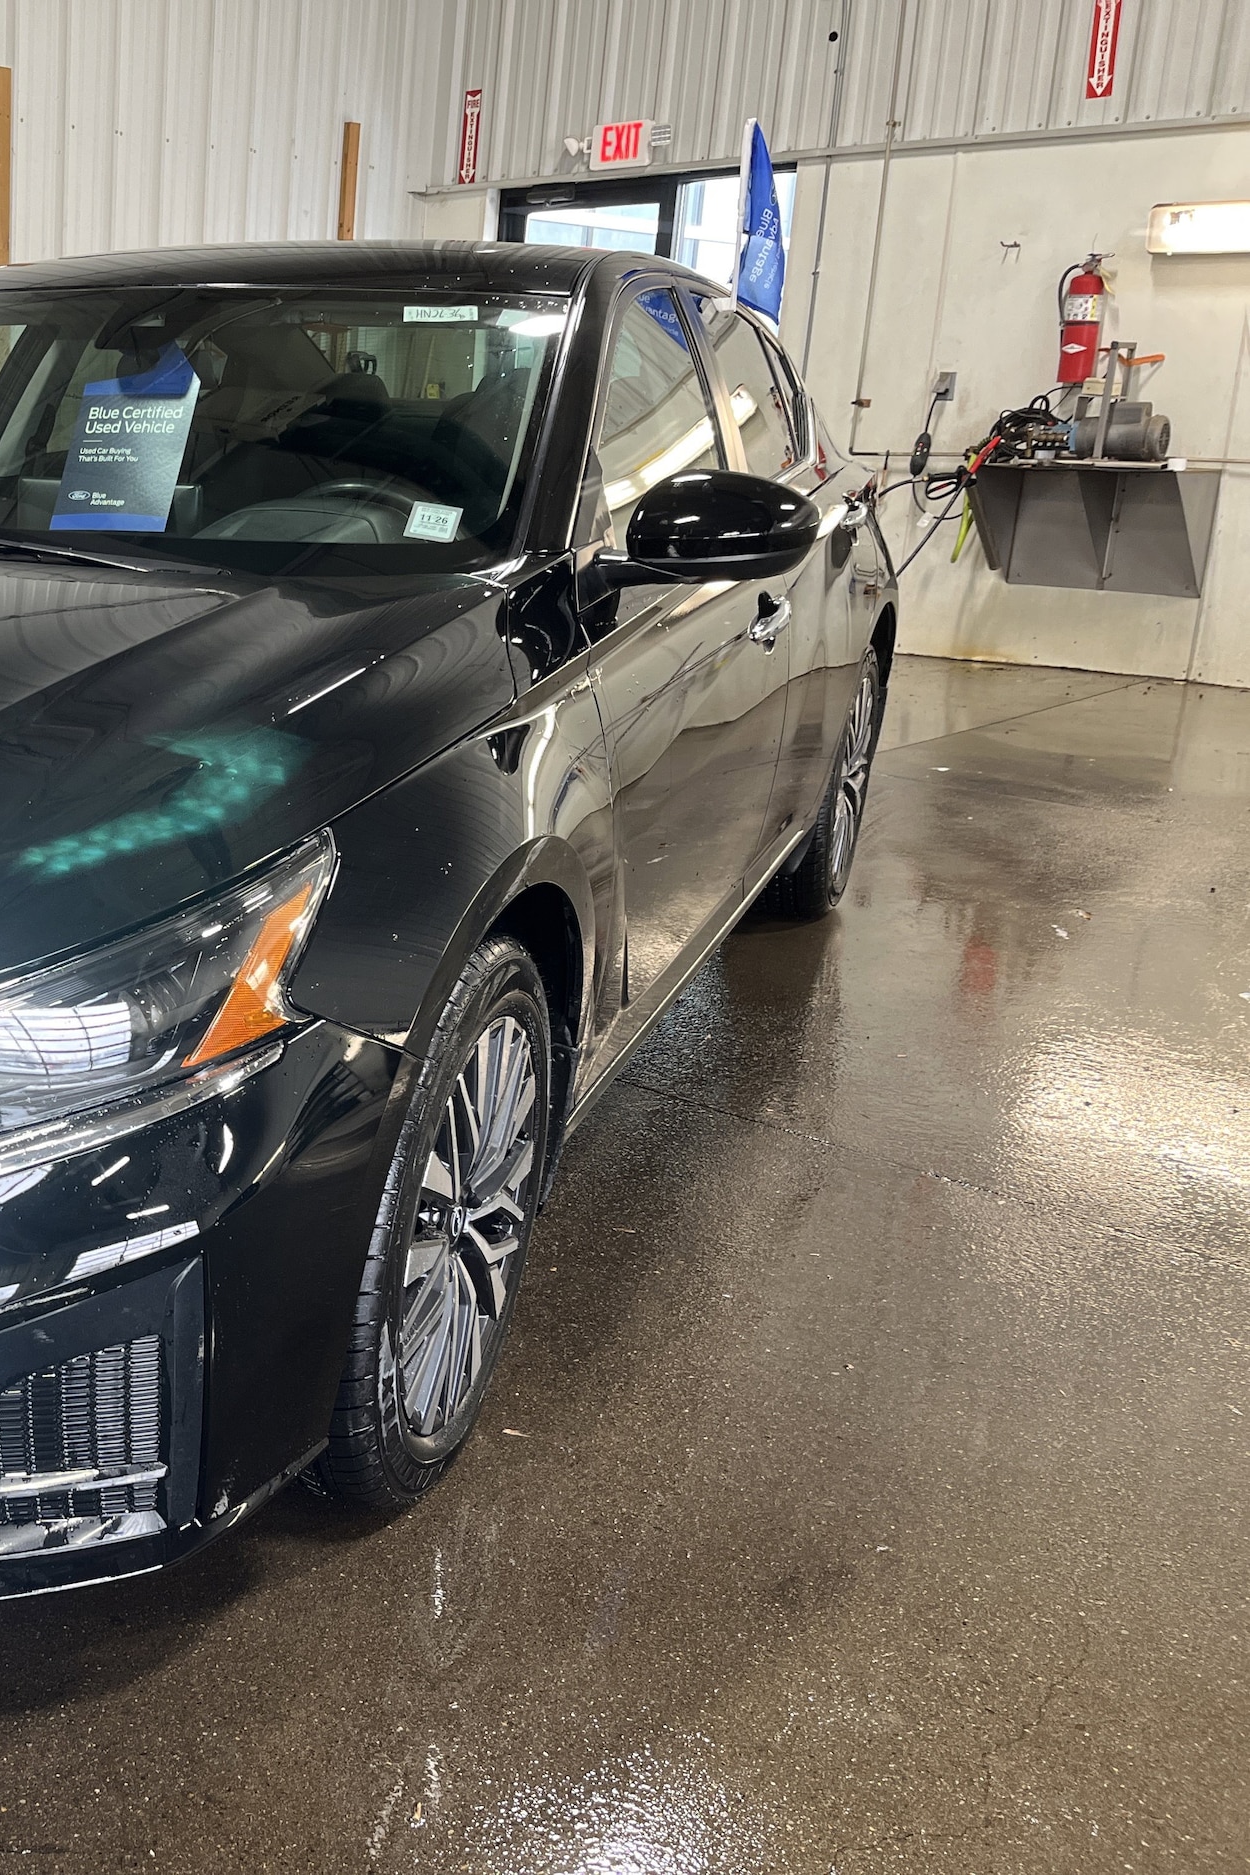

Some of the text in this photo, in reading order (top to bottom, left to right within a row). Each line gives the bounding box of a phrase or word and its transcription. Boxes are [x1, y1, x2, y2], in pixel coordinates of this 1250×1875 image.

[467, 99, 480, 109] FIRE
[465, 112, 475, 179] EXTINGUISHER
[600, 122, 644, 163] EXIT
[88, 406, 183, 420] Blue Certified
[85, 420, 174, 434] Used Vehicle
[109, 447, 131, 456] Buying
[92, 491, 107, 499] Blue
[90, 499, 125, 507] Advantage
[435, 515, 448, 525] 26
